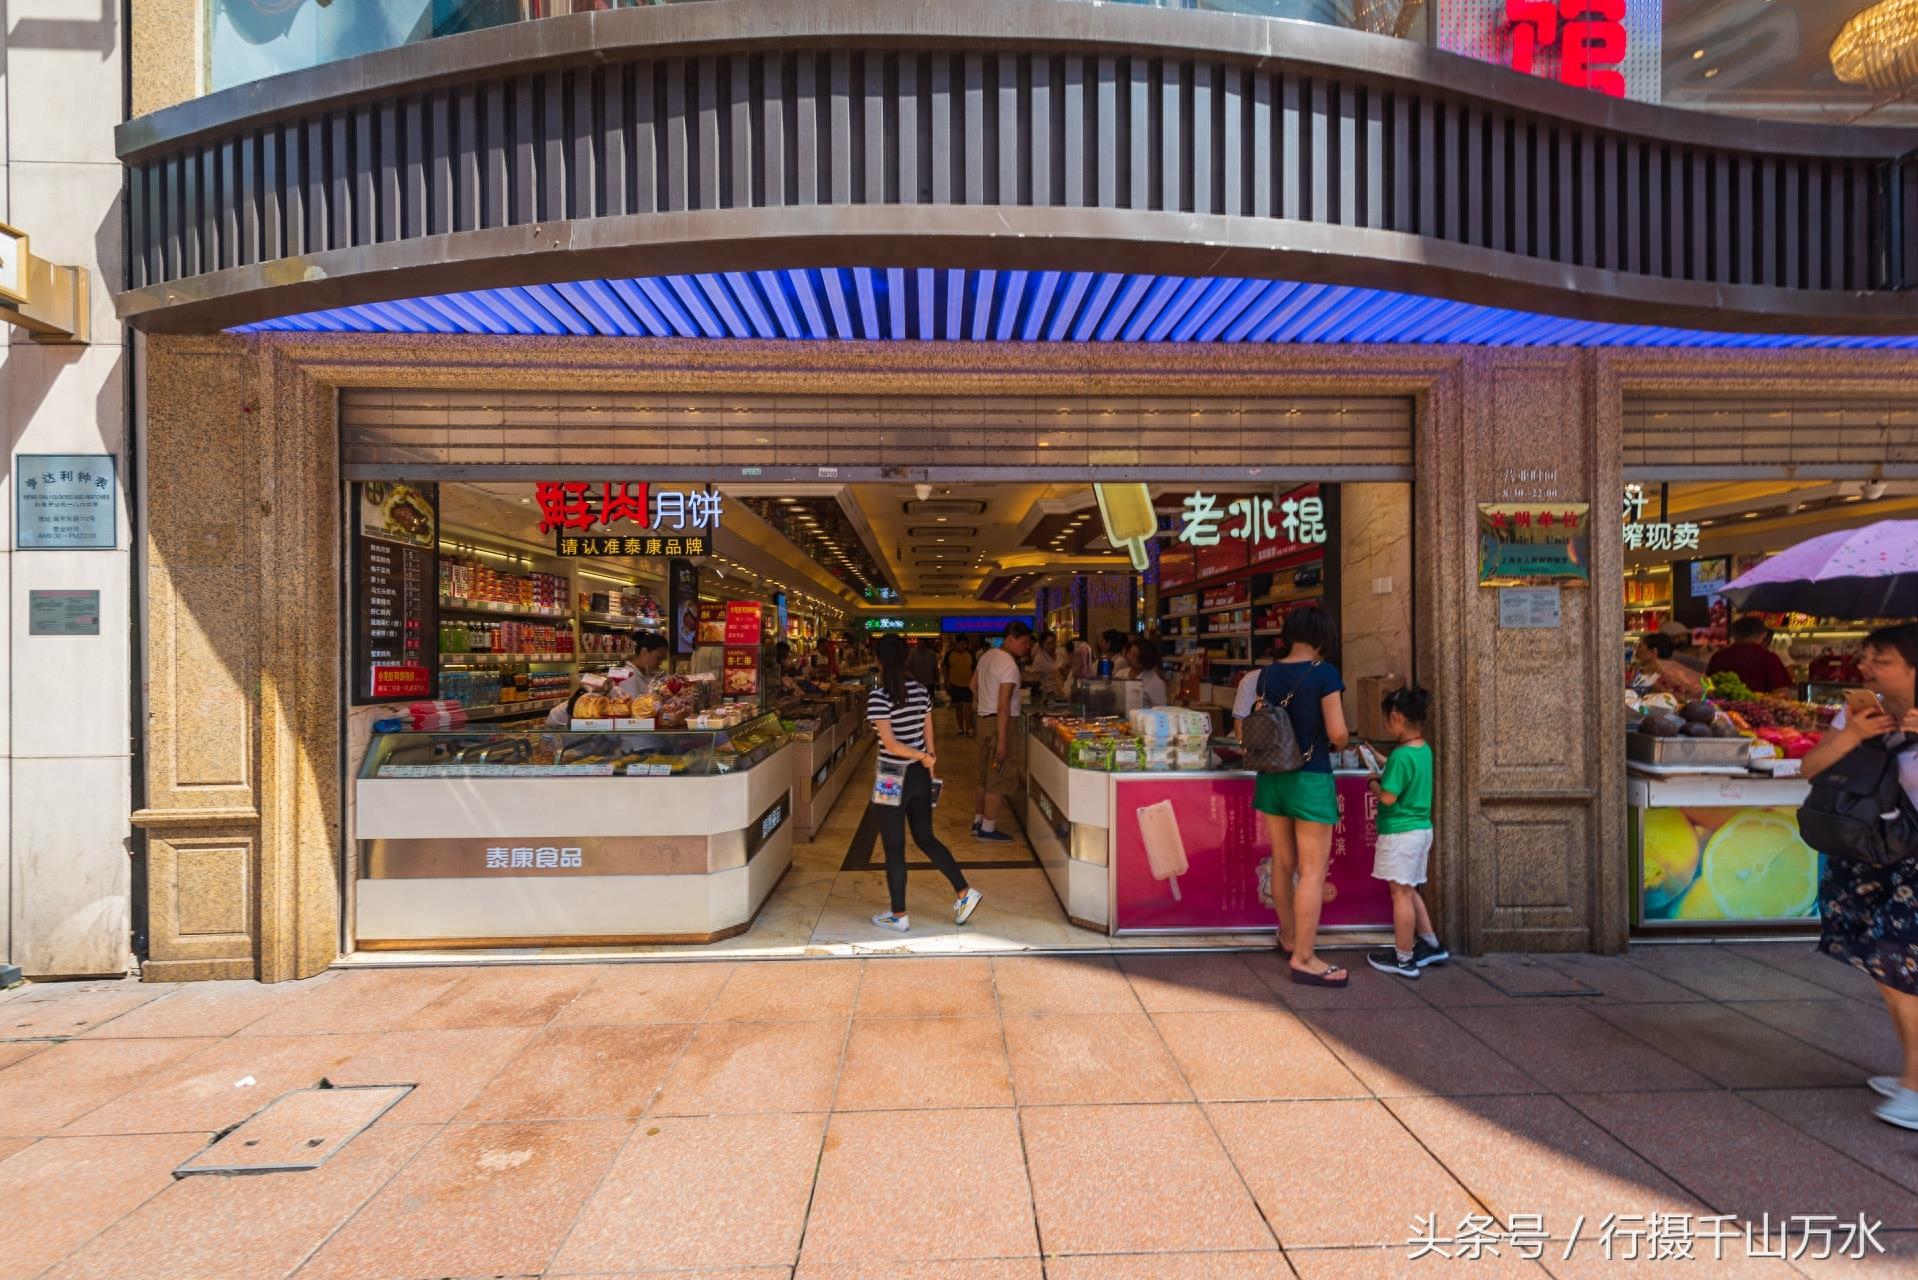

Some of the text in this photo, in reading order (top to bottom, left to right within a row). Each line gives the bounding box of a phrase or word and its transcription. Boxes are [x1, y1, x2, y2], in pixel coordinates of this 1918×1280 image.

[1179, 489, 1327, 546] 老冰棍
[1489, 510, 1578, 529] 文明单位
[561, 538, 704, 555] 请认准泰康品牌
[485, 847, 583, 869] 泰康食品
